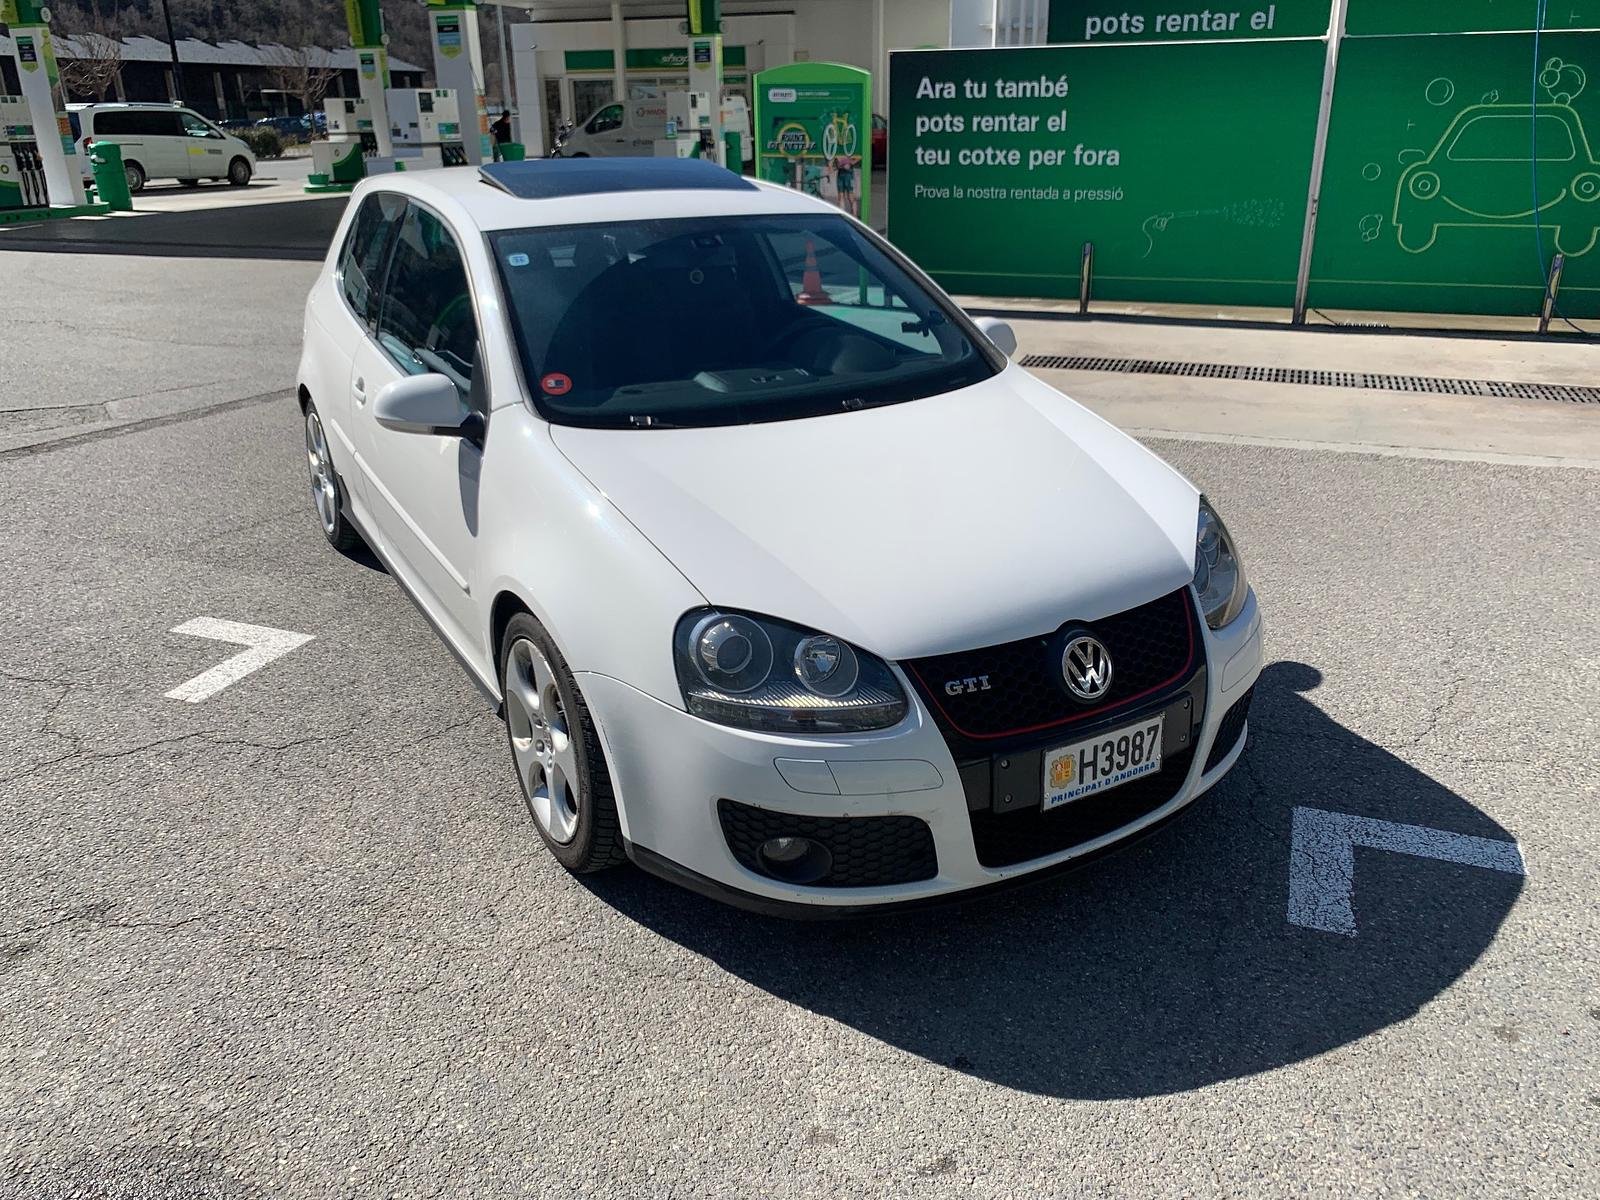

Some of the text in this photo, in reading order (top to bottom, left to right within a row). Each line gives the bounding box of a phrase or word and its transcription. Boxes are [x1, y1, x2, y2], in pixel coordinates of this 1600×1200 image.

[1085, 5, 1275, 40] pots rentar el
[916, 74, 1069, 99] Ara tu també
[915, 109, 1067, 137] pots rentar el
[915, 143, 1120, 171] teu cotxe per fora
[914, 184, 1124, 203] Prova la nostra rentada a pressió
[944, 674, 992, 696] GTI
[1079, 723, 1160, 785] H3987
[1051, 761, 1156, 804] PRINCIPAT D'ANDORRA
